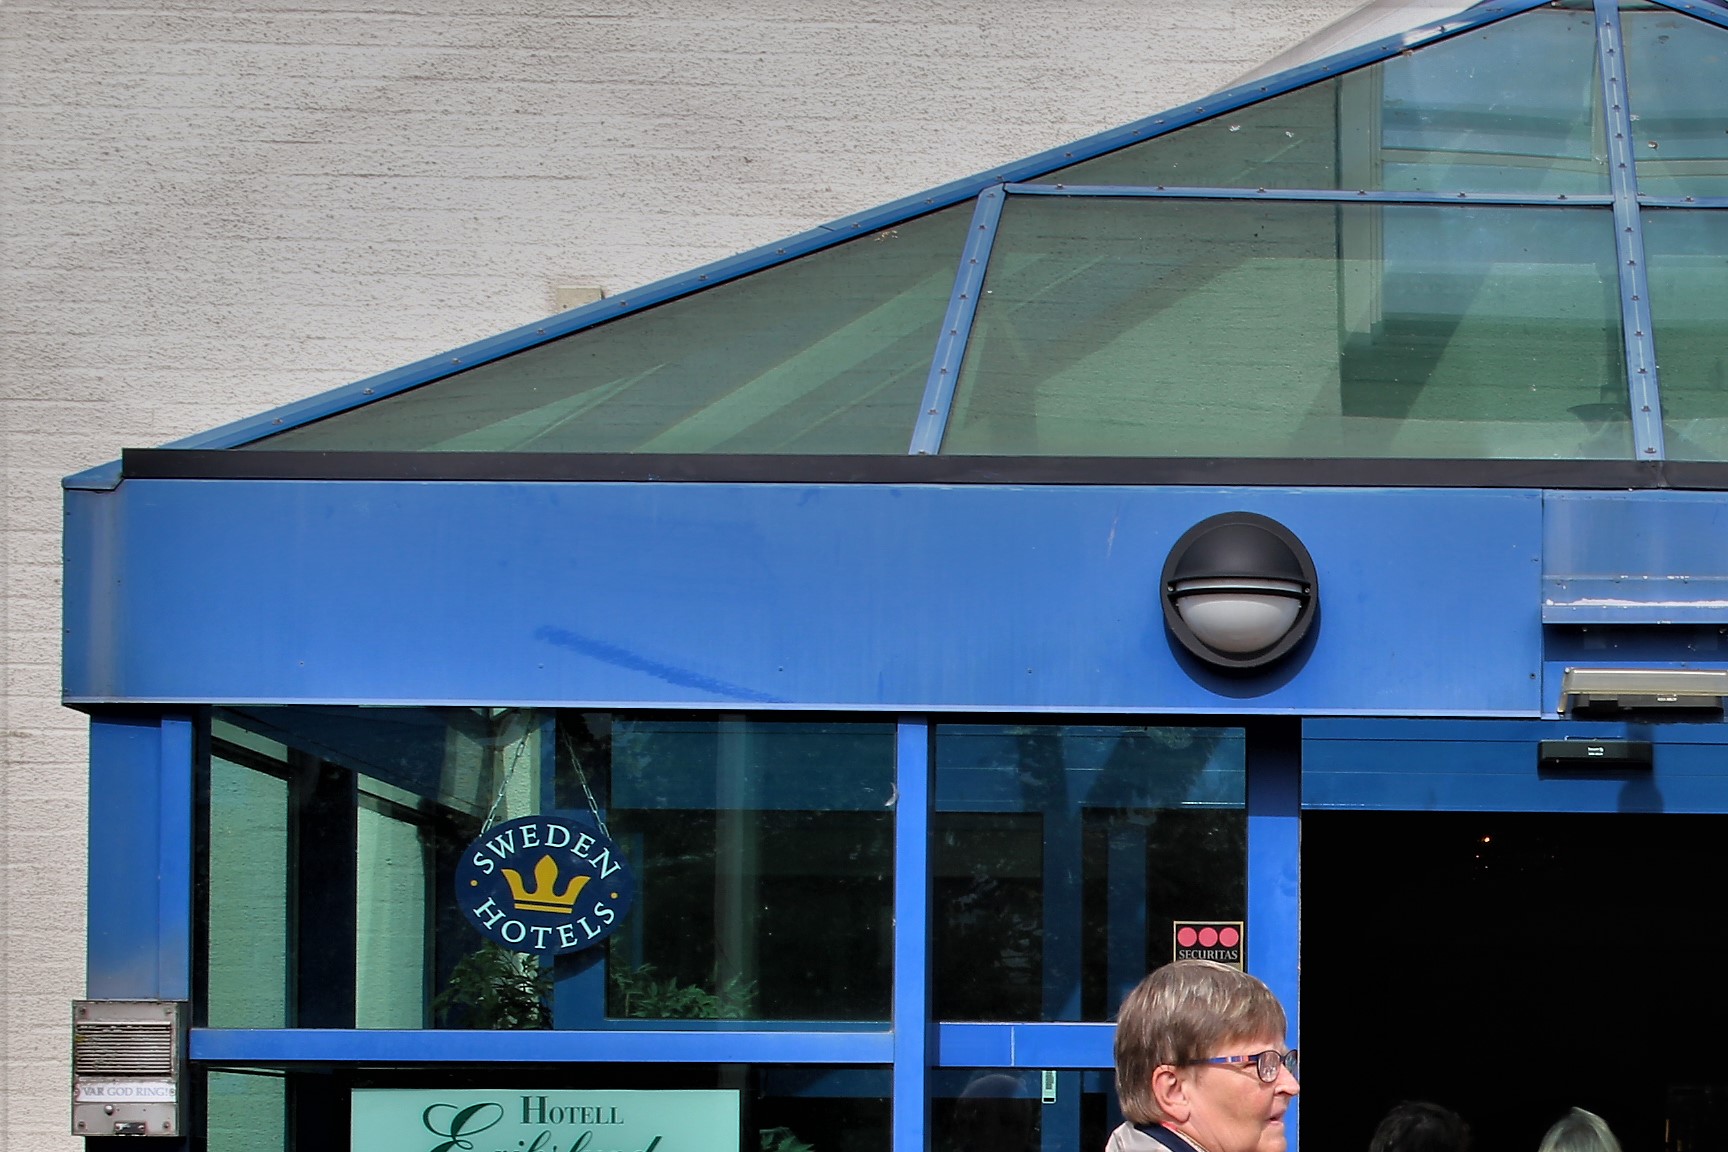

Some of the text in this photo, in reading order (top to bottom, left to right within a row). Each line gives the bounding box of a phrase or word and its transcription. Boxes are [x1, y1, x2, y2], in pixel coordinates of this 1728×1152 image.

[472, 824, 622, 880] SWEDEN
[472, 897, 615, 949] HOTELS
[1178, 949, 1238, 960] SECURITAS
[107, 1086, 134, 1097] GOD
[136, 1086, 169, 1097] RING!
[519, 1096, 624, 1125] HOTELL
